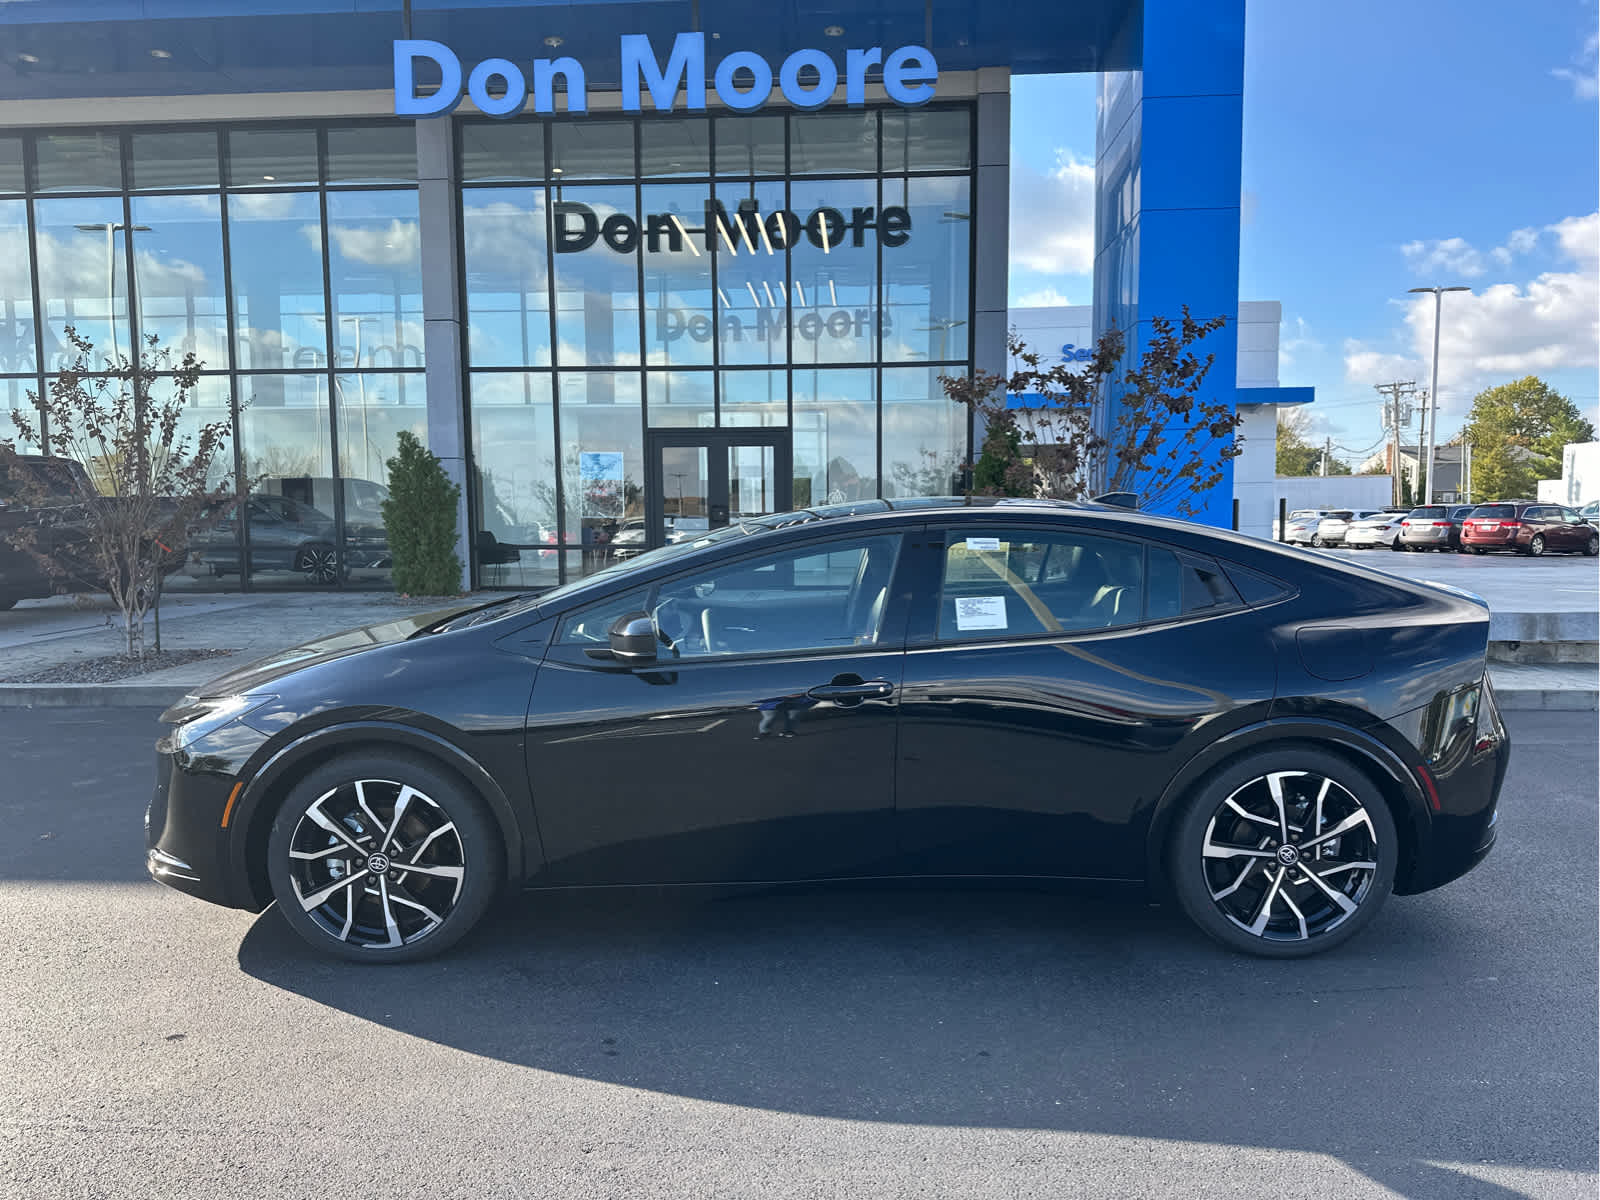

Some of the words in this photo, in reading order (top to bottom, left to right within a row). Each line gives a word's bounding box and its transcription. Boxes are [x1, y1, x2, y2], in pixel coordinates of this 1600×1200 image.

[393, 39, 589, 118] Don
[620, 31, 937, 112] Moore
[553, 200, 682, 254] Don
[704, 198, 912, 252] Moore
[656, 308, 743, 343] Don
[756, 307, 893, 343] Moore
